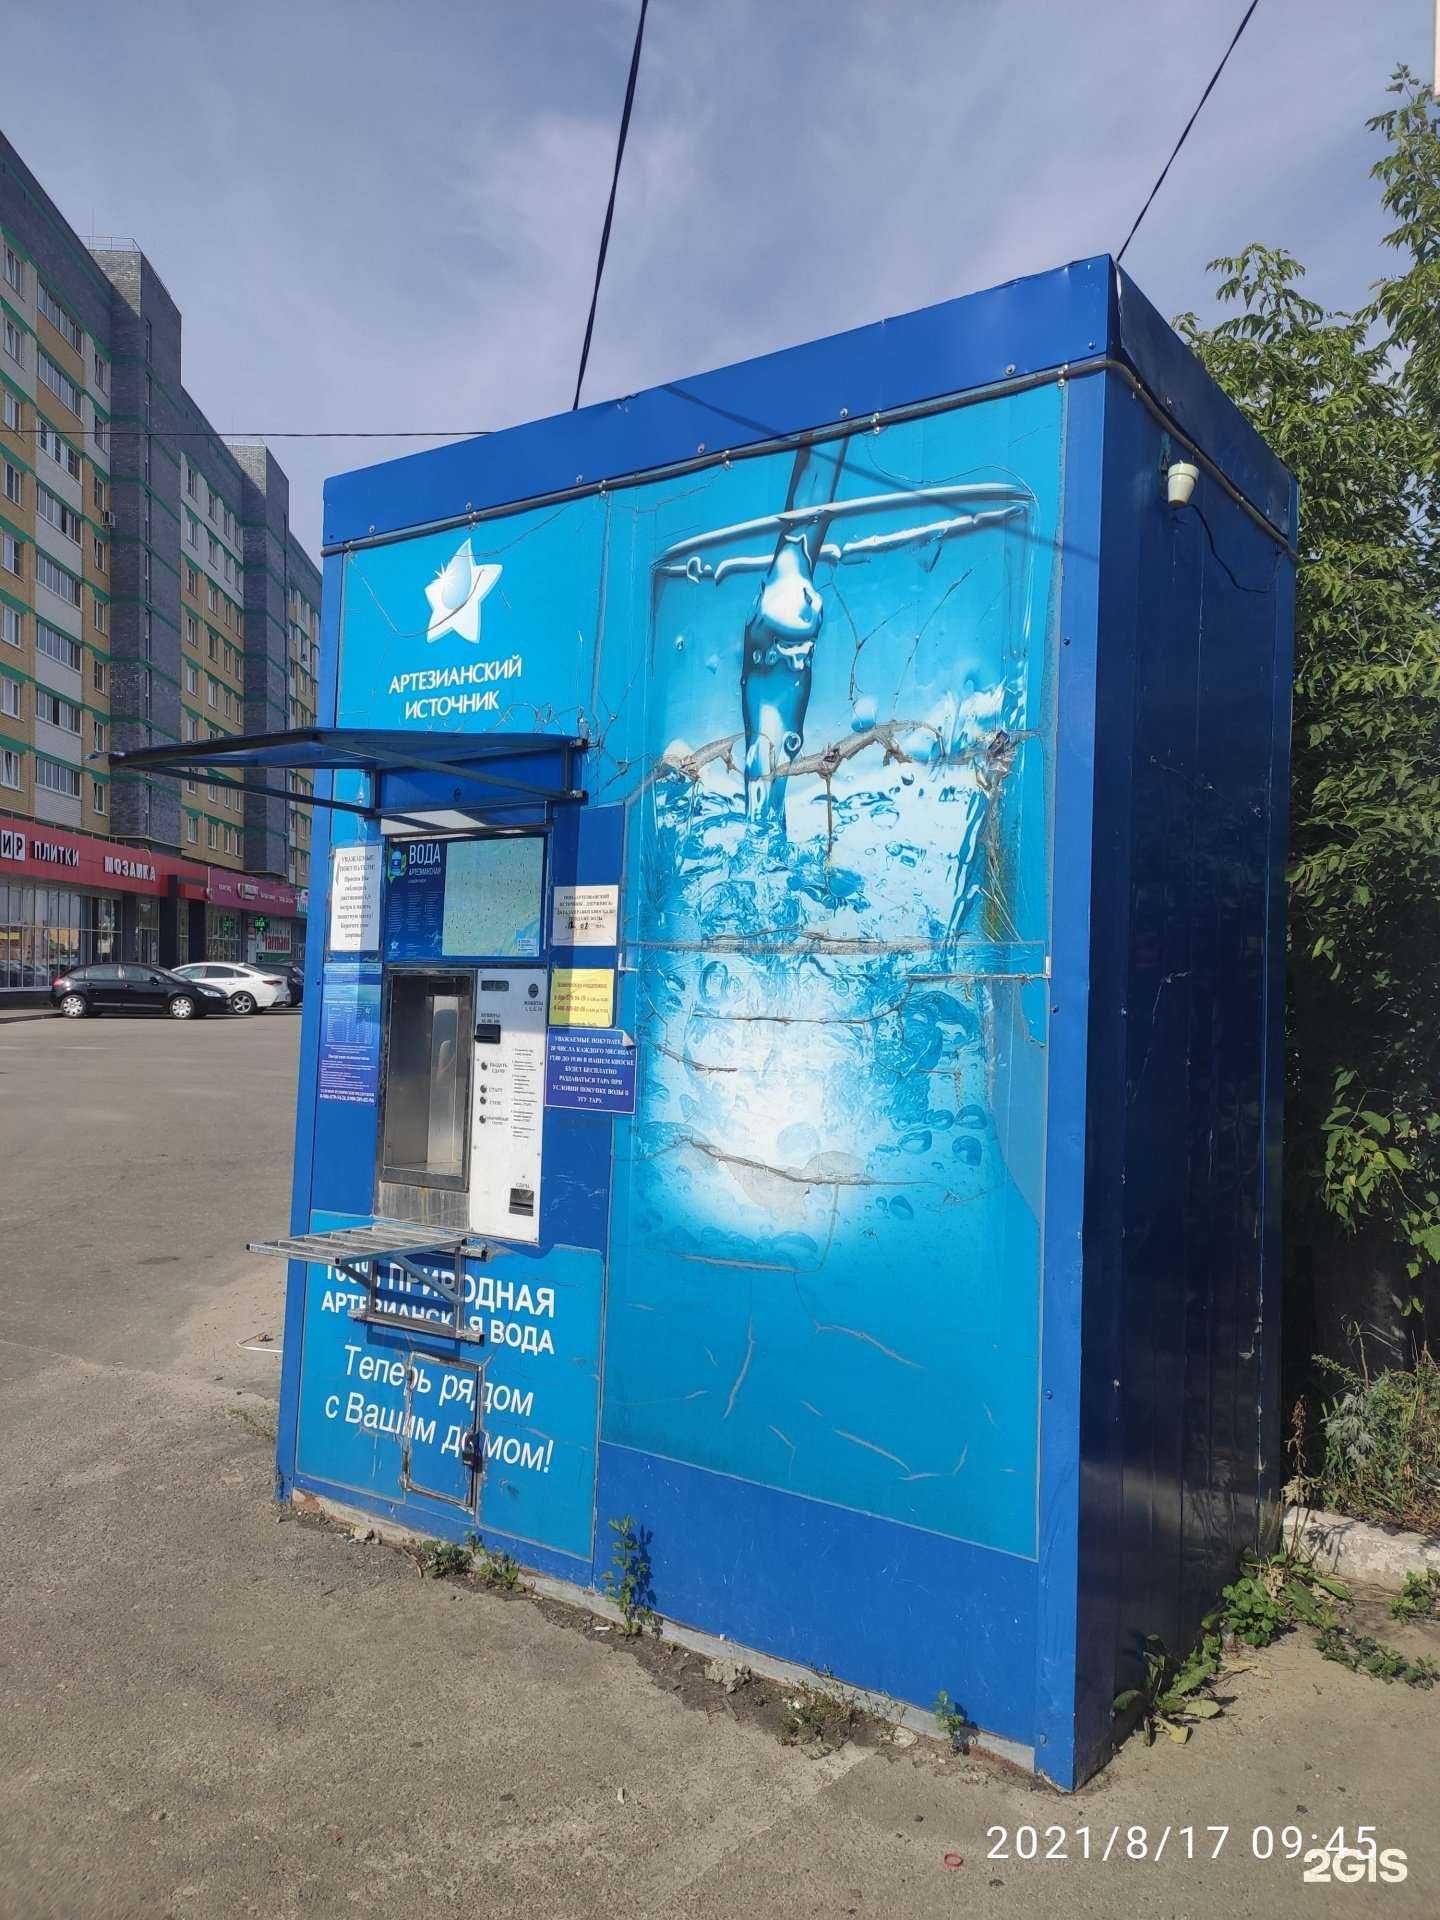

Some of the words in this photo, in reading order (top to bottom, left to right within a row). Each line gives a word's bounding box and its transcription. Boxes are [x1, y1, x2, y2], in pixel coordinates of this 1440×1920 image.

[388, 654, 522, 694] АРТЕЗИАНСКИЙ
[405, 690, 499, 720] ИСТОЧНИК
[33, 840, 80, 867] ПЛИТКИ
[104, 855, 156, 882] МОЗАИКА
[408, 843, 441, 866] ВОДА
[321, 1290, 484, 1334] АРТЕЗИАНСКЯ
[490, 1319, 555, 1356] ВОДА
[344, 1345, 432, 1397] Теперь
[438, 1374, 534, 1416] рядом
[325, 1394, 340, 1419] с
[344, 1391, 437, 1445] Вашим
